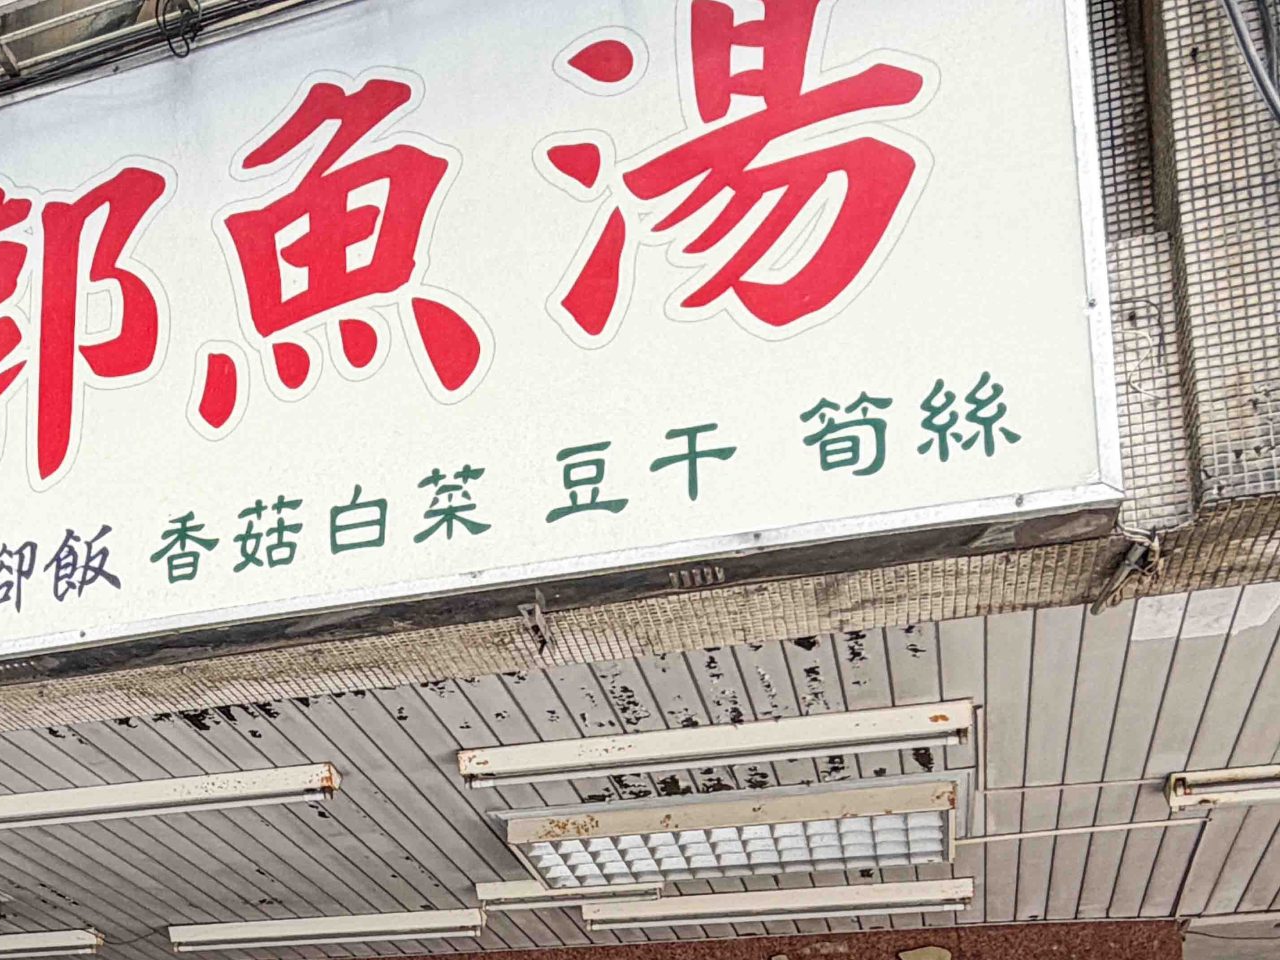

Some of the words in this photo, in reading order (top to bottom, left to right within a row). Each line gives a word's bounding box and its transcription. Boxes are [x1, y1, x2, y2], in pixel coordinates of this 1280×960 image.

[150, 464, 492, 584] 香菇白菜
[545, 422, 737, 523] 豆干
[801, 371, 1021, 477] 筍絲
